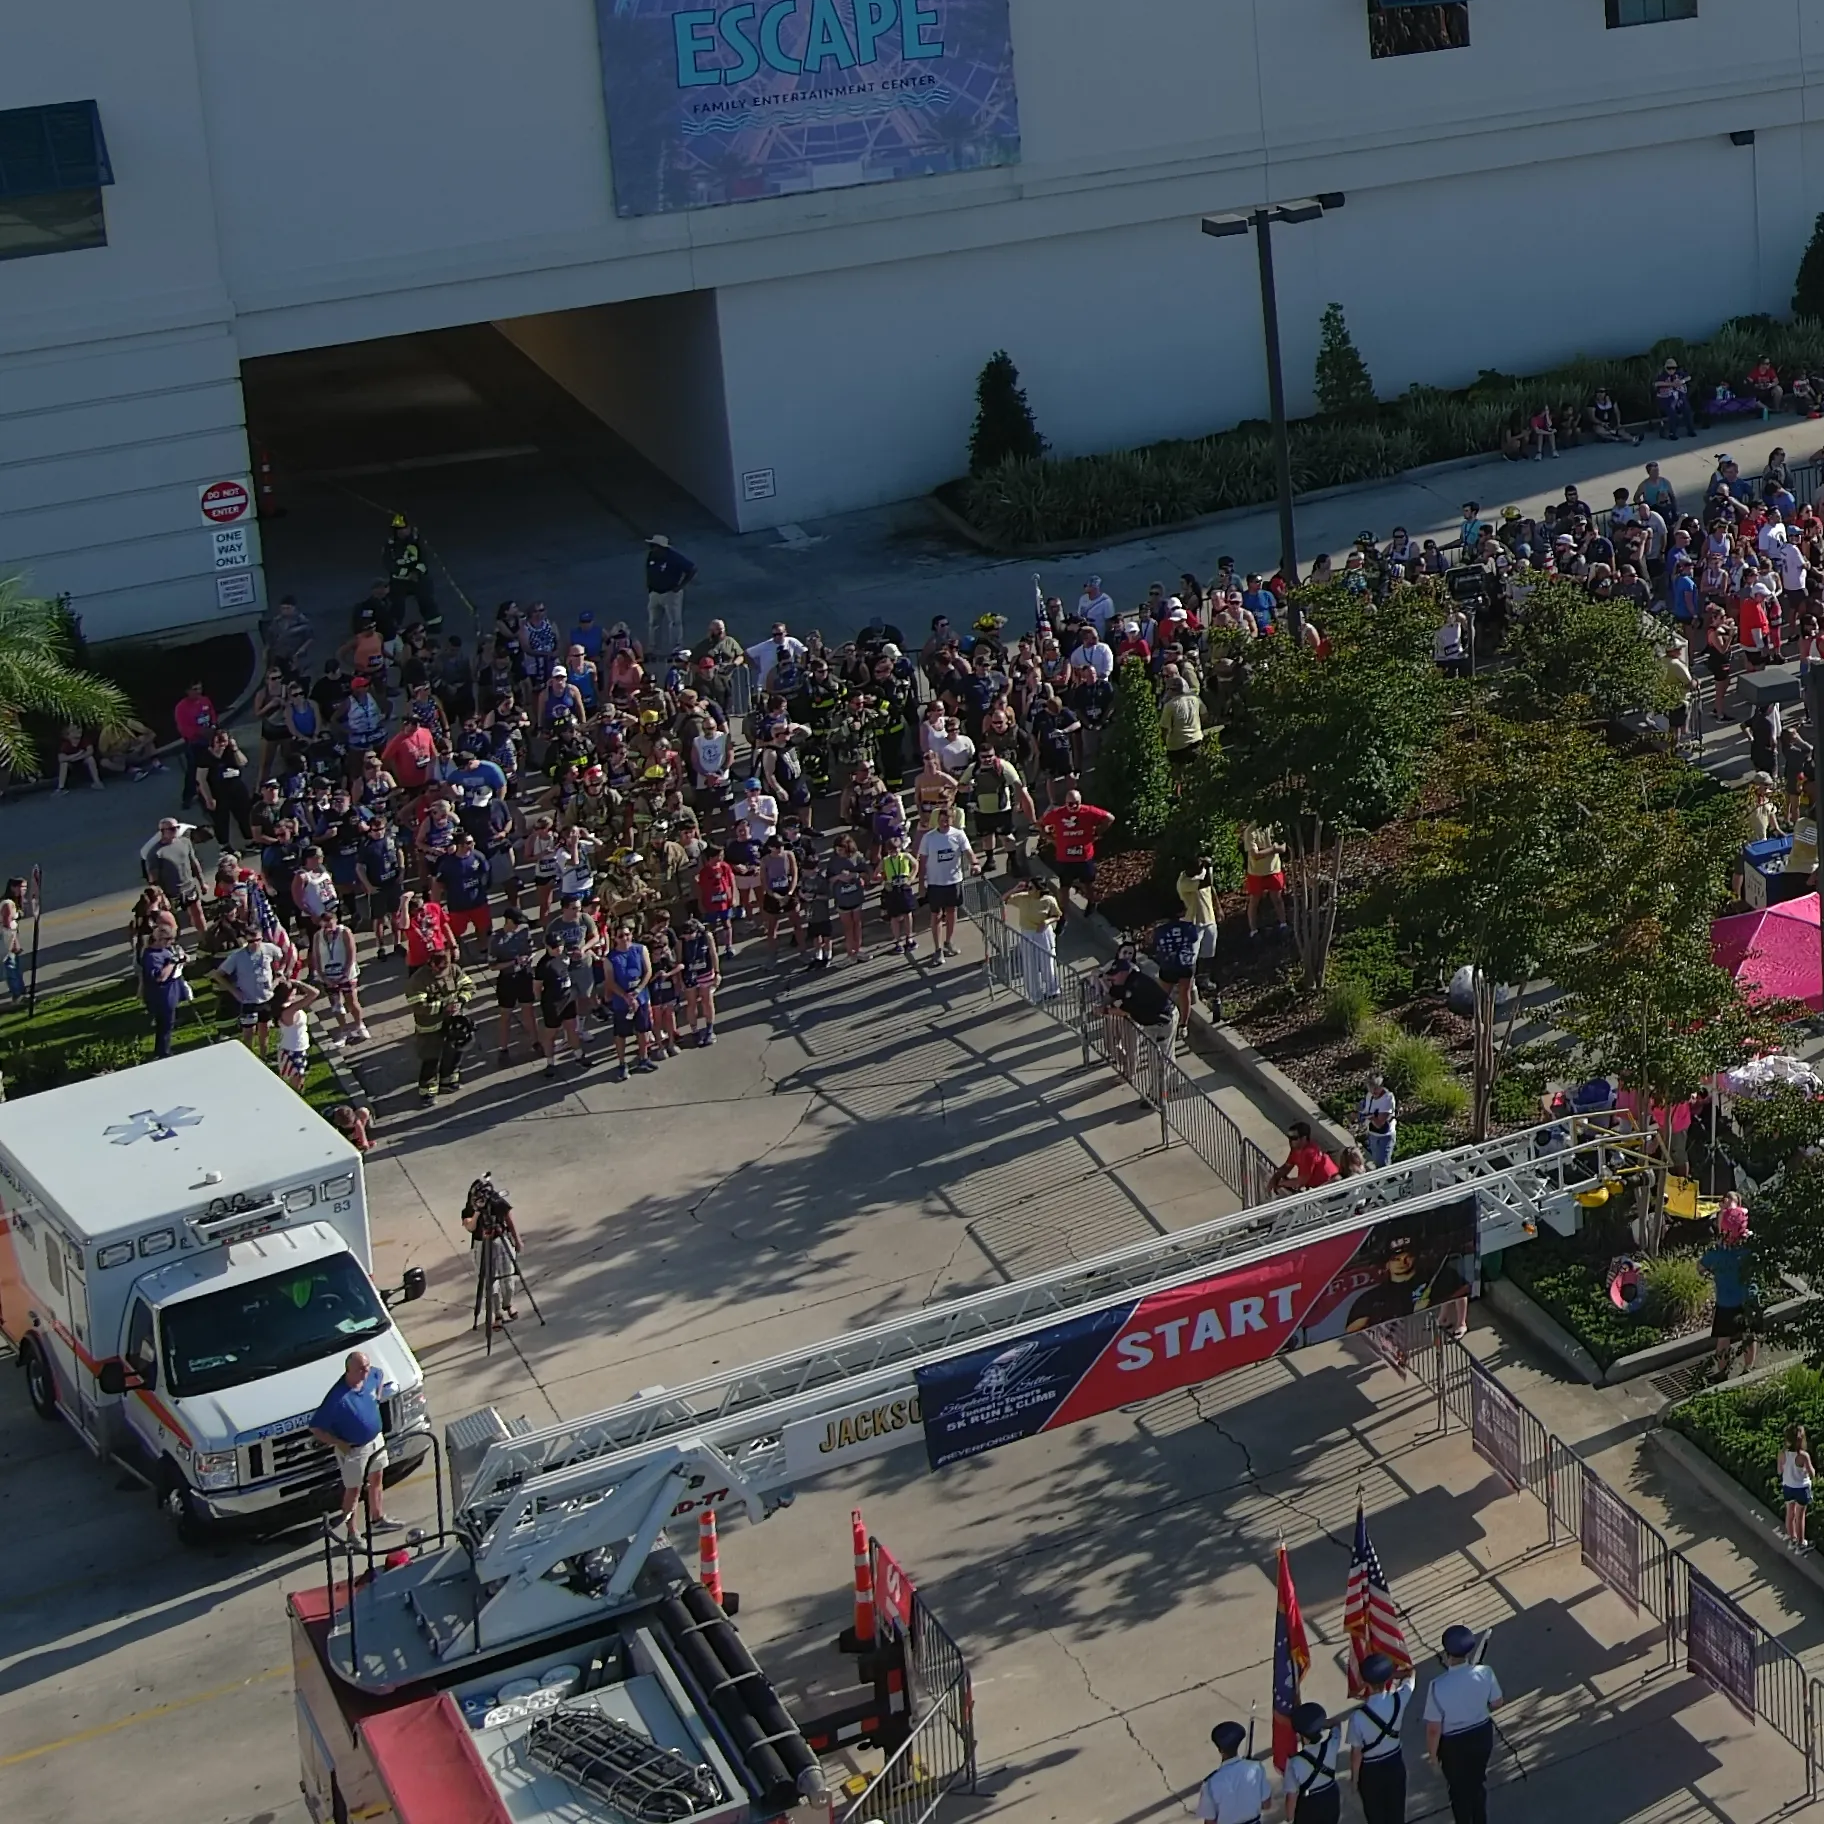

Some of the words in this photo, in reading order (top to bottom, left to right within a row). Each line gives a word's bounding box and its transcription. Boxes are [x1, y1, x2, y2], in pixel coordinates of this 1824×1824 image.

[693, 98, 747, 114] FAMILY
[752, 82, 875, 107] ENTERTAINMENT
[881, 74, 937, 91] CENTER
[207, 491, 220, 500] DO
[222, 487, 240, 497] NOT
[212, 506, 239, 517] ENTER
[216, 530, 242, 543] ONE
[217, 543, 243, 555] WAY
[215, 554, 247, 567] ONLY
[1115, 1282, 1302, 1372] START
[1005, 1388, 1042, 1405] Towers
[946, 1419, 967, 1432] 5K
[970, 1409, 1002, 1425] RUN
[1003, 1405, 1014, 1414] &
[1015, 1389, 1057, 1410] CLIMB
